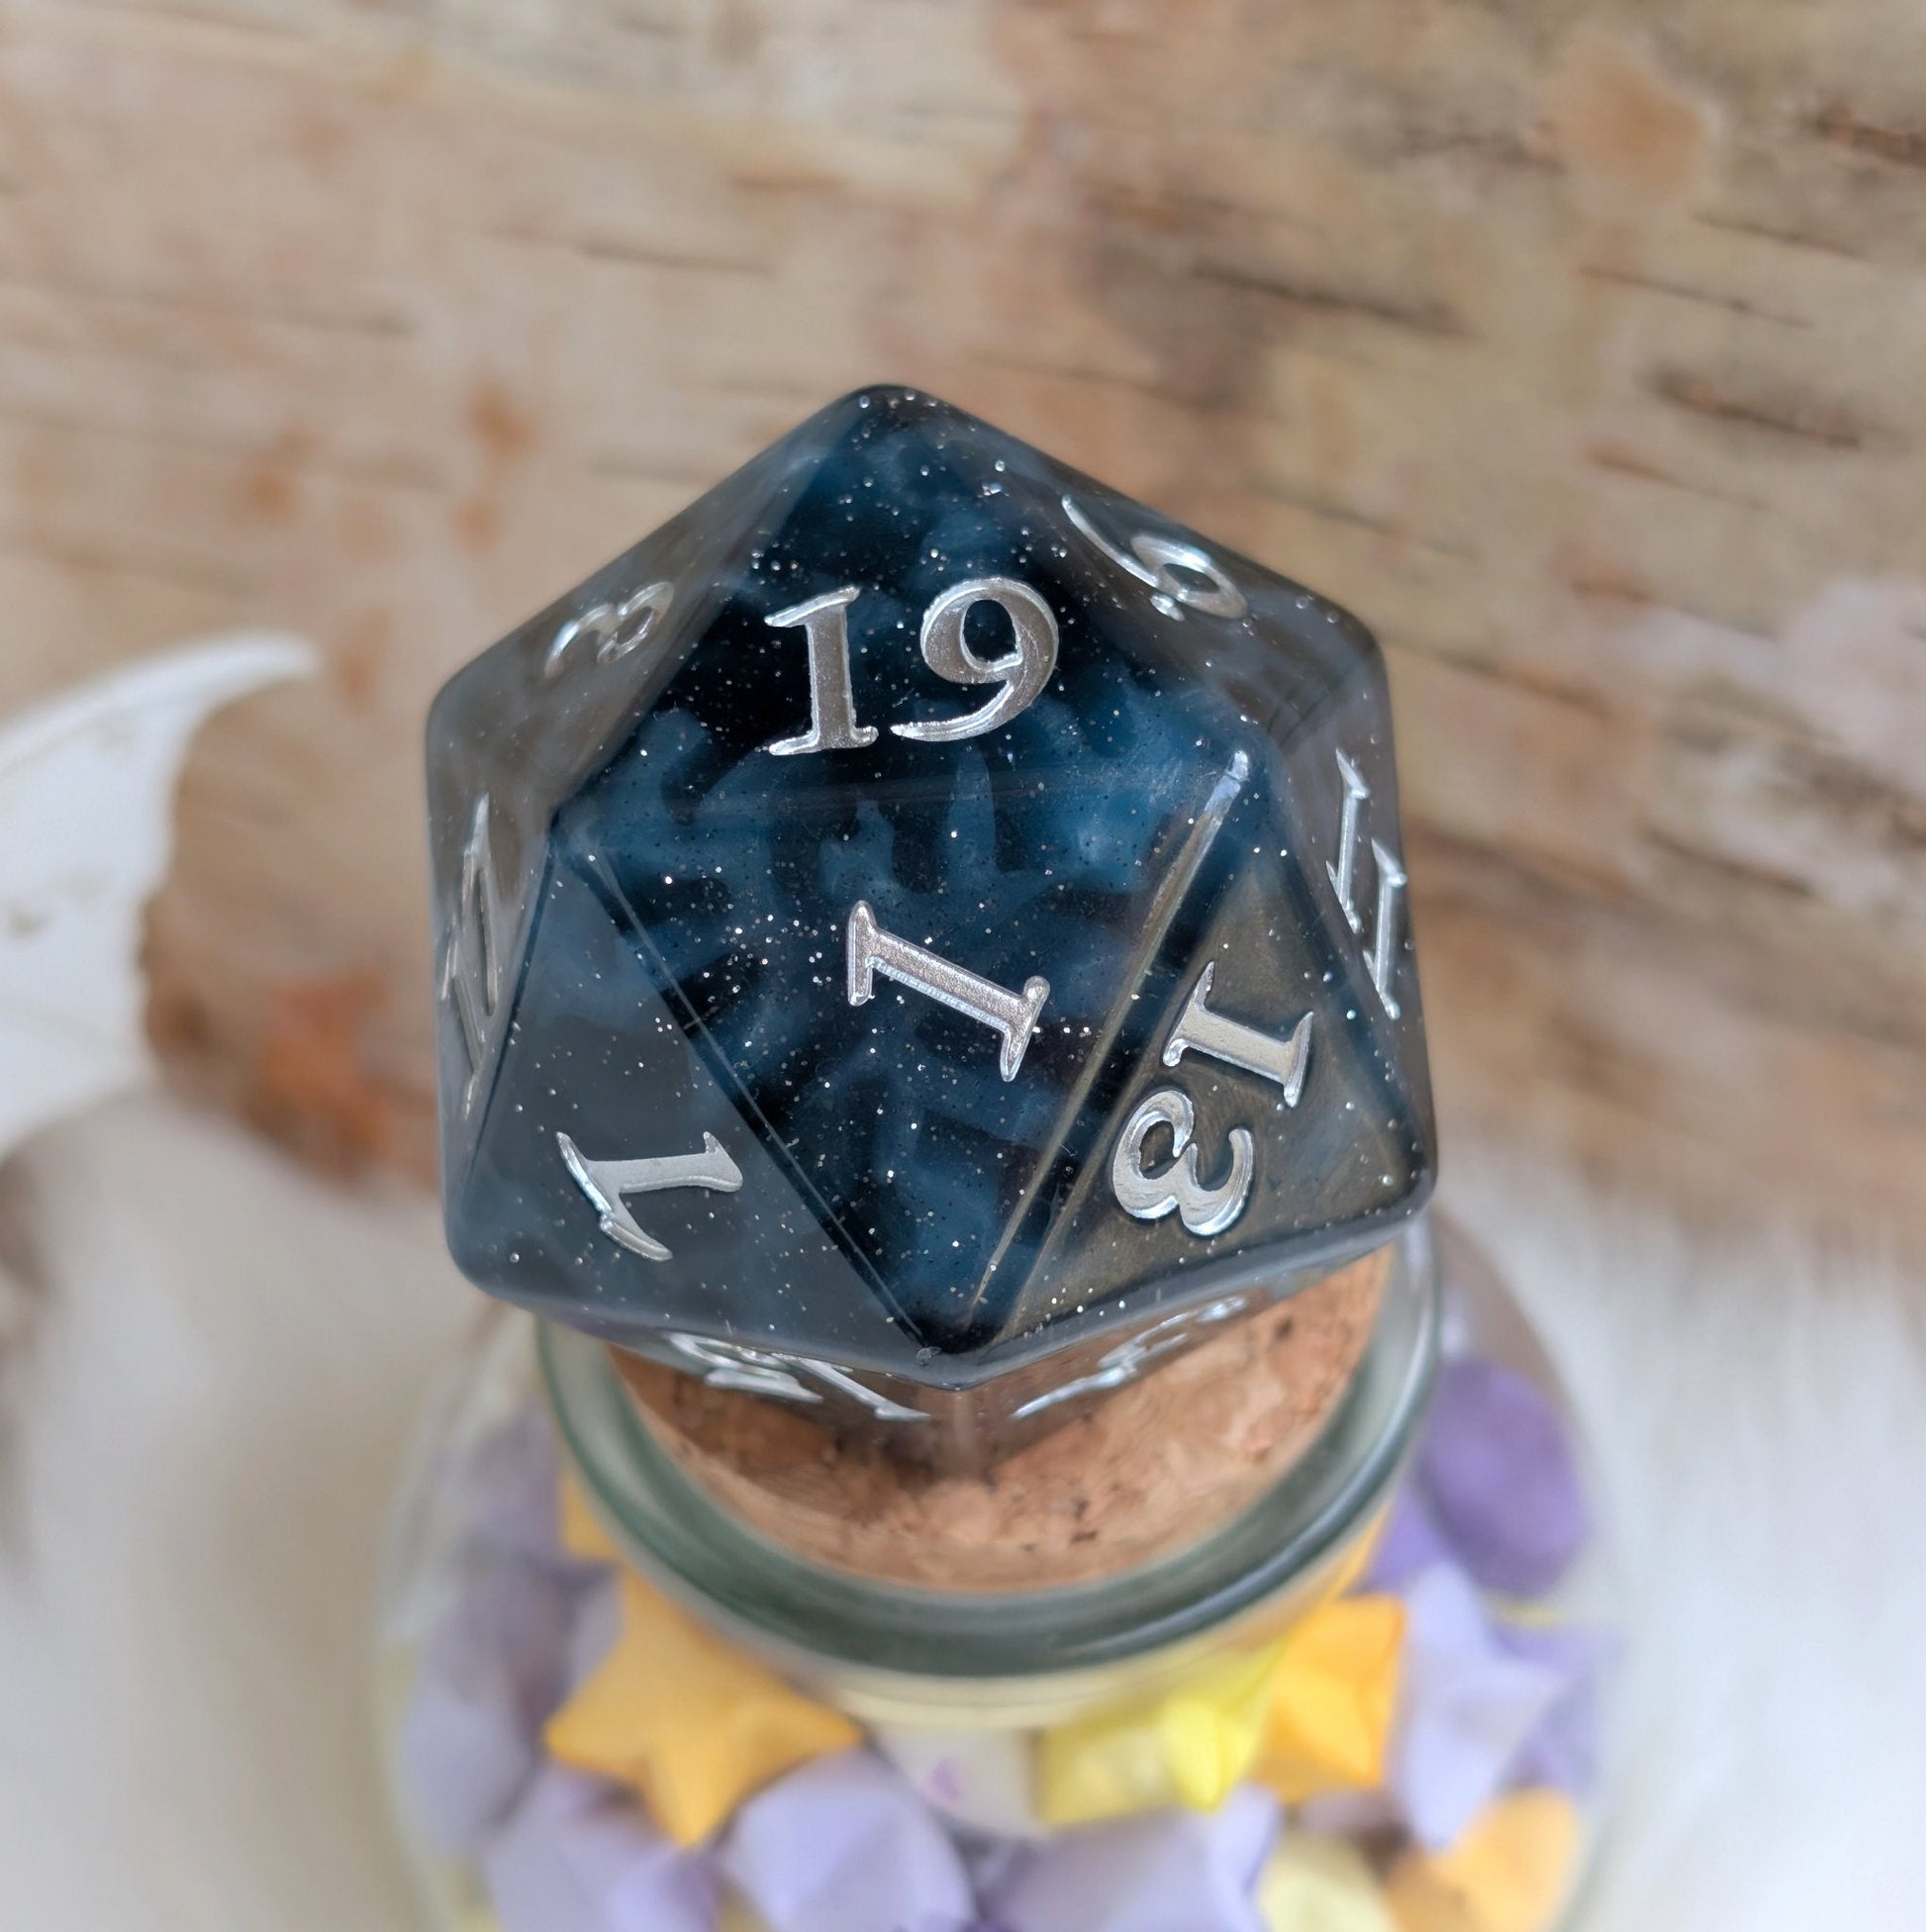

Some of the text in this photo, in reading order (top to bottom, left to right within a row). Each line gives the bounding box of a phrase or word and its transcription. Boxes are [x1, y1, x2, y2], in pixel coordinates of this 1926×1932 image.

[543, 580, 674, 680] 3
[764, 576, 1059, 755] 19
[1325, 747, 1407, 1020] 11
[846, 900, 1050, 1082] 1
[1112, 960, 1313, 1237] 13
